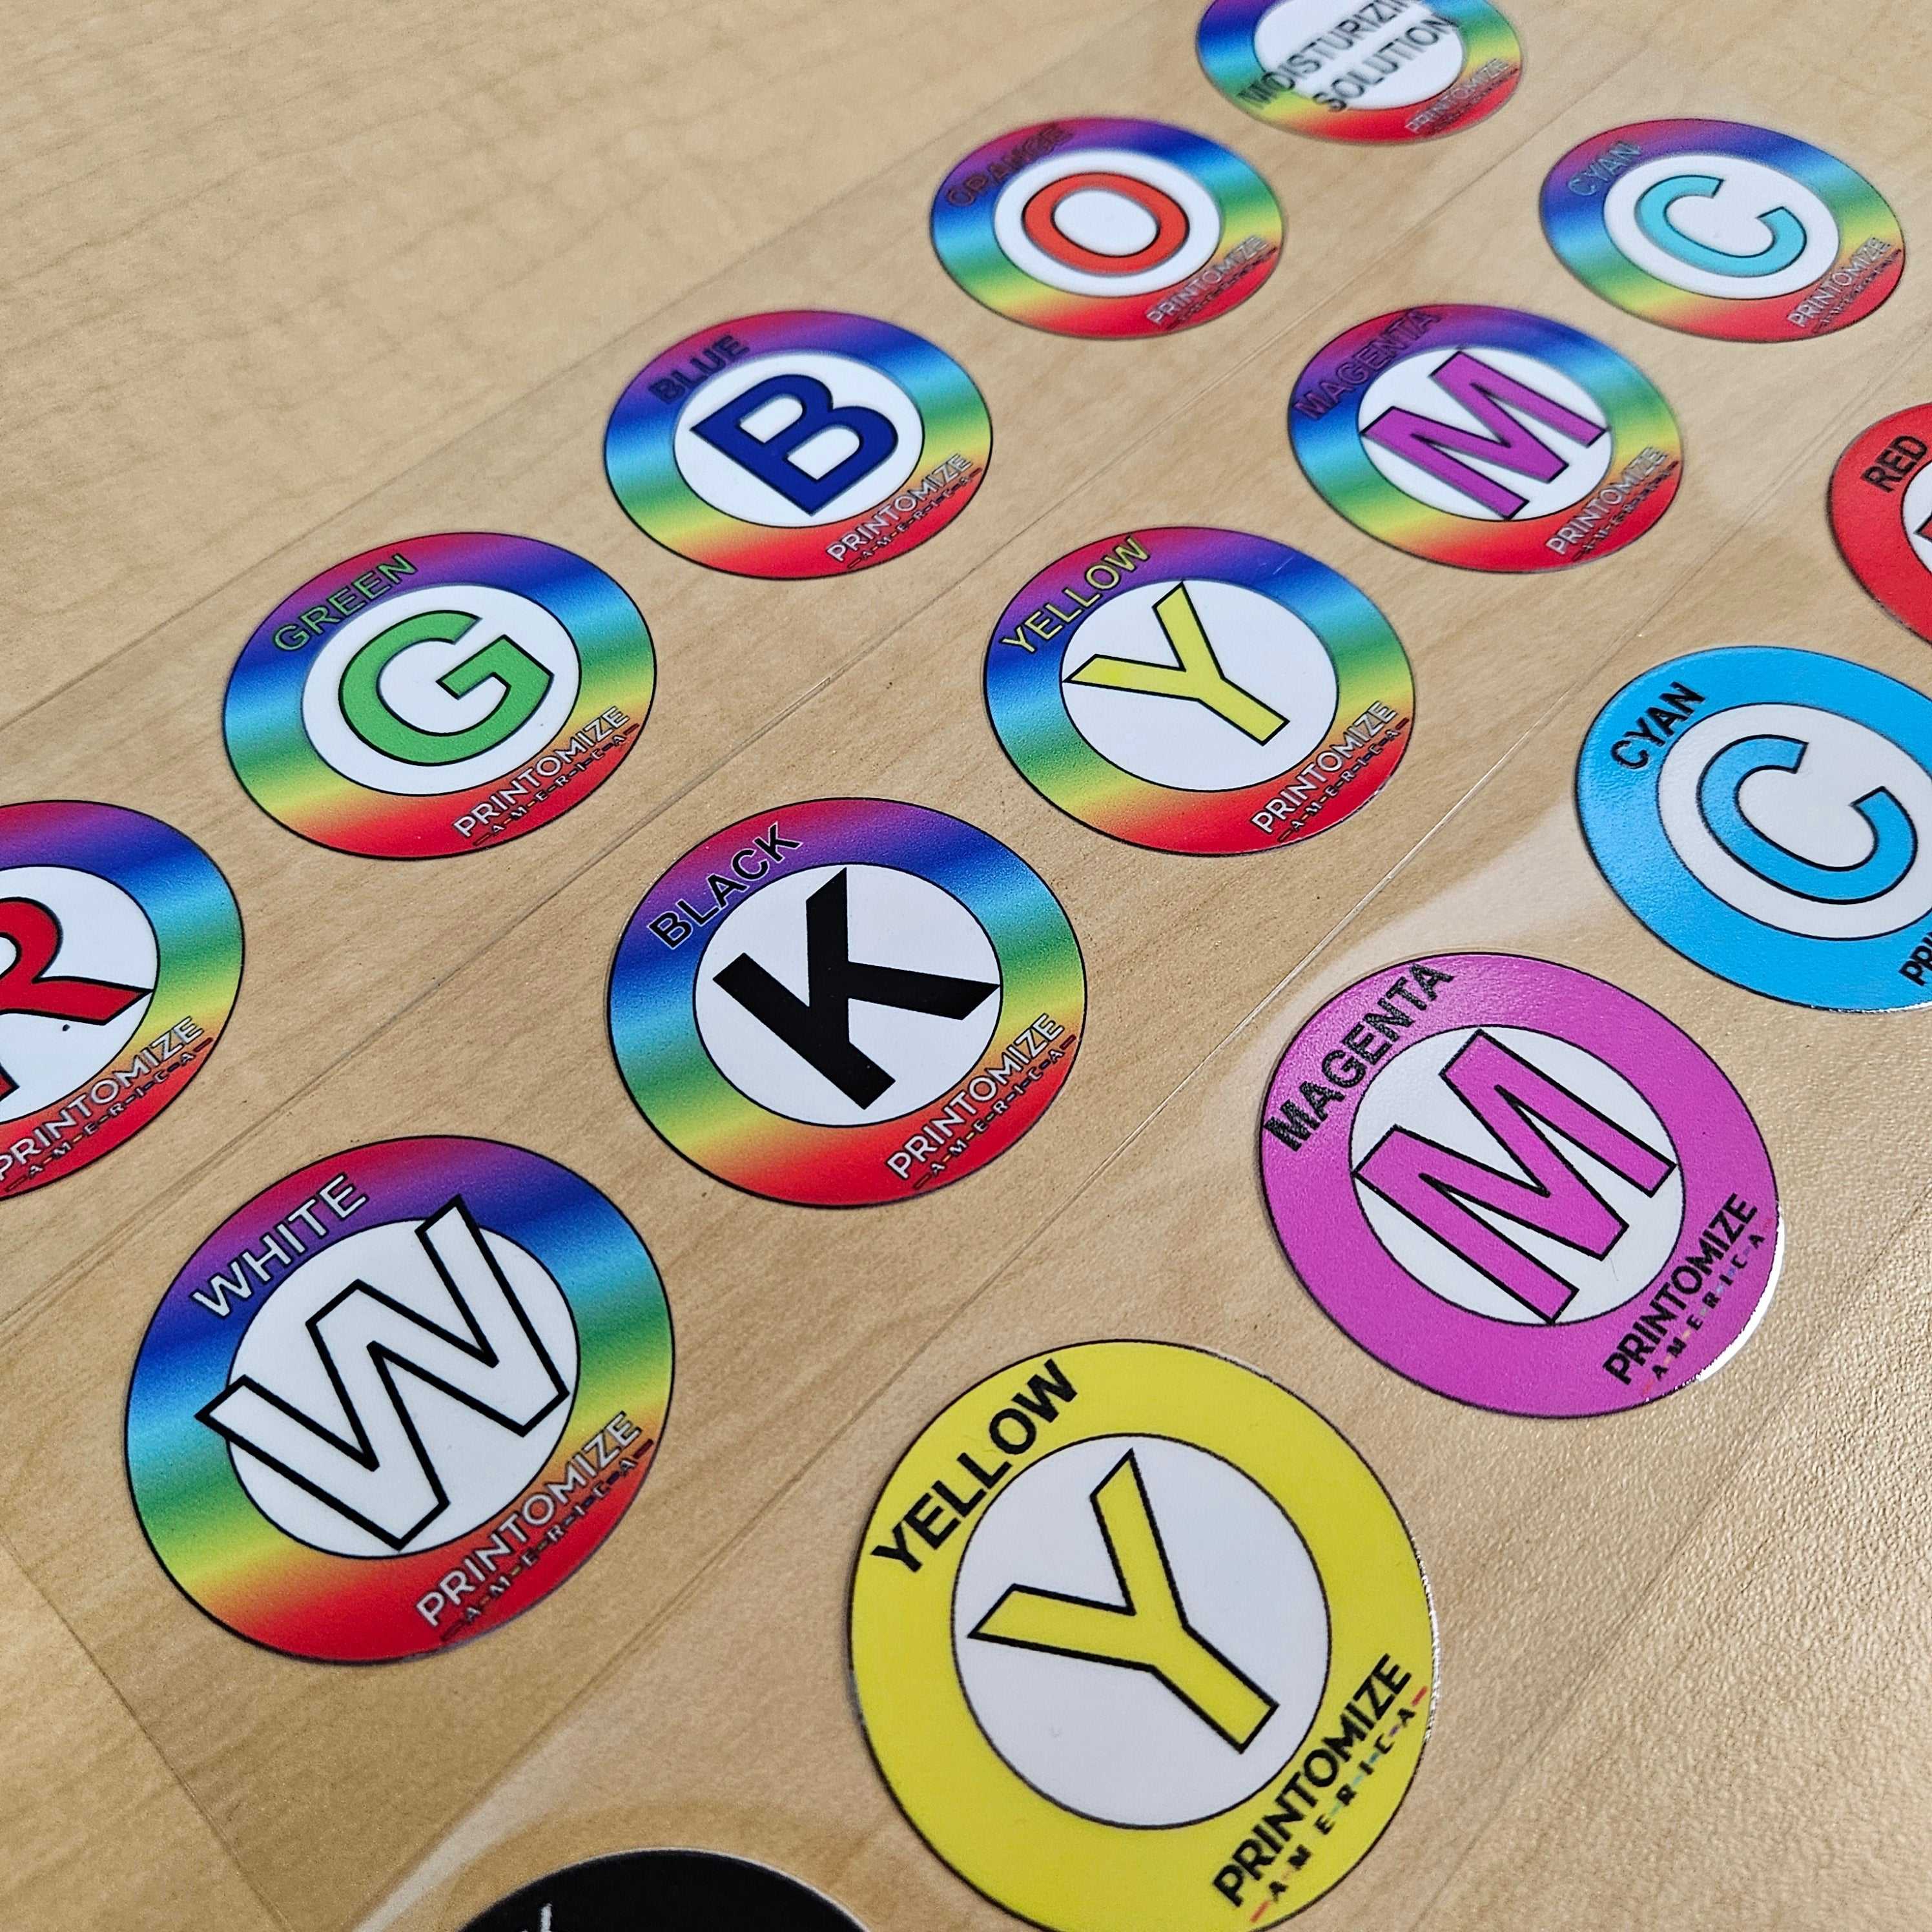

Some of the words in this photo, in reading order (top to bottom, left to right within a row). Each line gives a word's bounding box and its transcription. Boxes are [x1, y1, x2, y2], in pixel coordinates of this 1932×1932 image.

[1313, 12, 1459, 112] SOLUTION
[1022, 172, 1189, 278] O
[1567, 141, 1642, 196] CYAN
[1634, 174, 1807, 278] C
[1146, 235, 1269, 325] PRINTOMIZE
[1787, 237, 1891, 327] PRINTOMIZE
[649, 334, 750, 404] BLUE
[1293, 309, 1442, 420] MAGENTA
[690, 374, 898, 515] B
[1361, 351, 1608, 520] M
[1545, 447, 1668, 555] PRINTOMIZE
[1860, 435, 1928, 493] RED
[825, 453, 973, 562] PRINTOMIZE
[272, 553, 418, 652] GREEN
[1000, 533, 1151, 653] YELLOW
[338, 610, 555, 766] G
[1062, 582, 1290, 746] Y
[1610, 681, 1706, 769] CYAN
[451, 706, 631, 838] PRINTOMIZE
[1250, 700, 1398, 835] PRINTOMIZE
[1696, 734, 1918, 905] C
[648, 821, 803, 949] BLACK
[712, 867, 1000, 1109] K
[0, 1016, 204, 1182] PRINTOMIZE
[885, 1012, 1065, 1180] PRINTOMIZE
[1264, 963, 1455, 1152] MAGENTA
[1353, 1029, 1677, 1324] M
[192, 1173, 369, 1319] WHITE
[1602, 1193, 1758, 1385] PRINTOMIZE
[194, 1195, 570, 1551] W
[416, 1410, 644, 1628] PRINTOMIZE
[871, 1358, 1078, 1573] YELLOW
[967, 1448, 1279, 1753] Y
[1212, 1653, 1412, 1907] PRINTOMIZE
